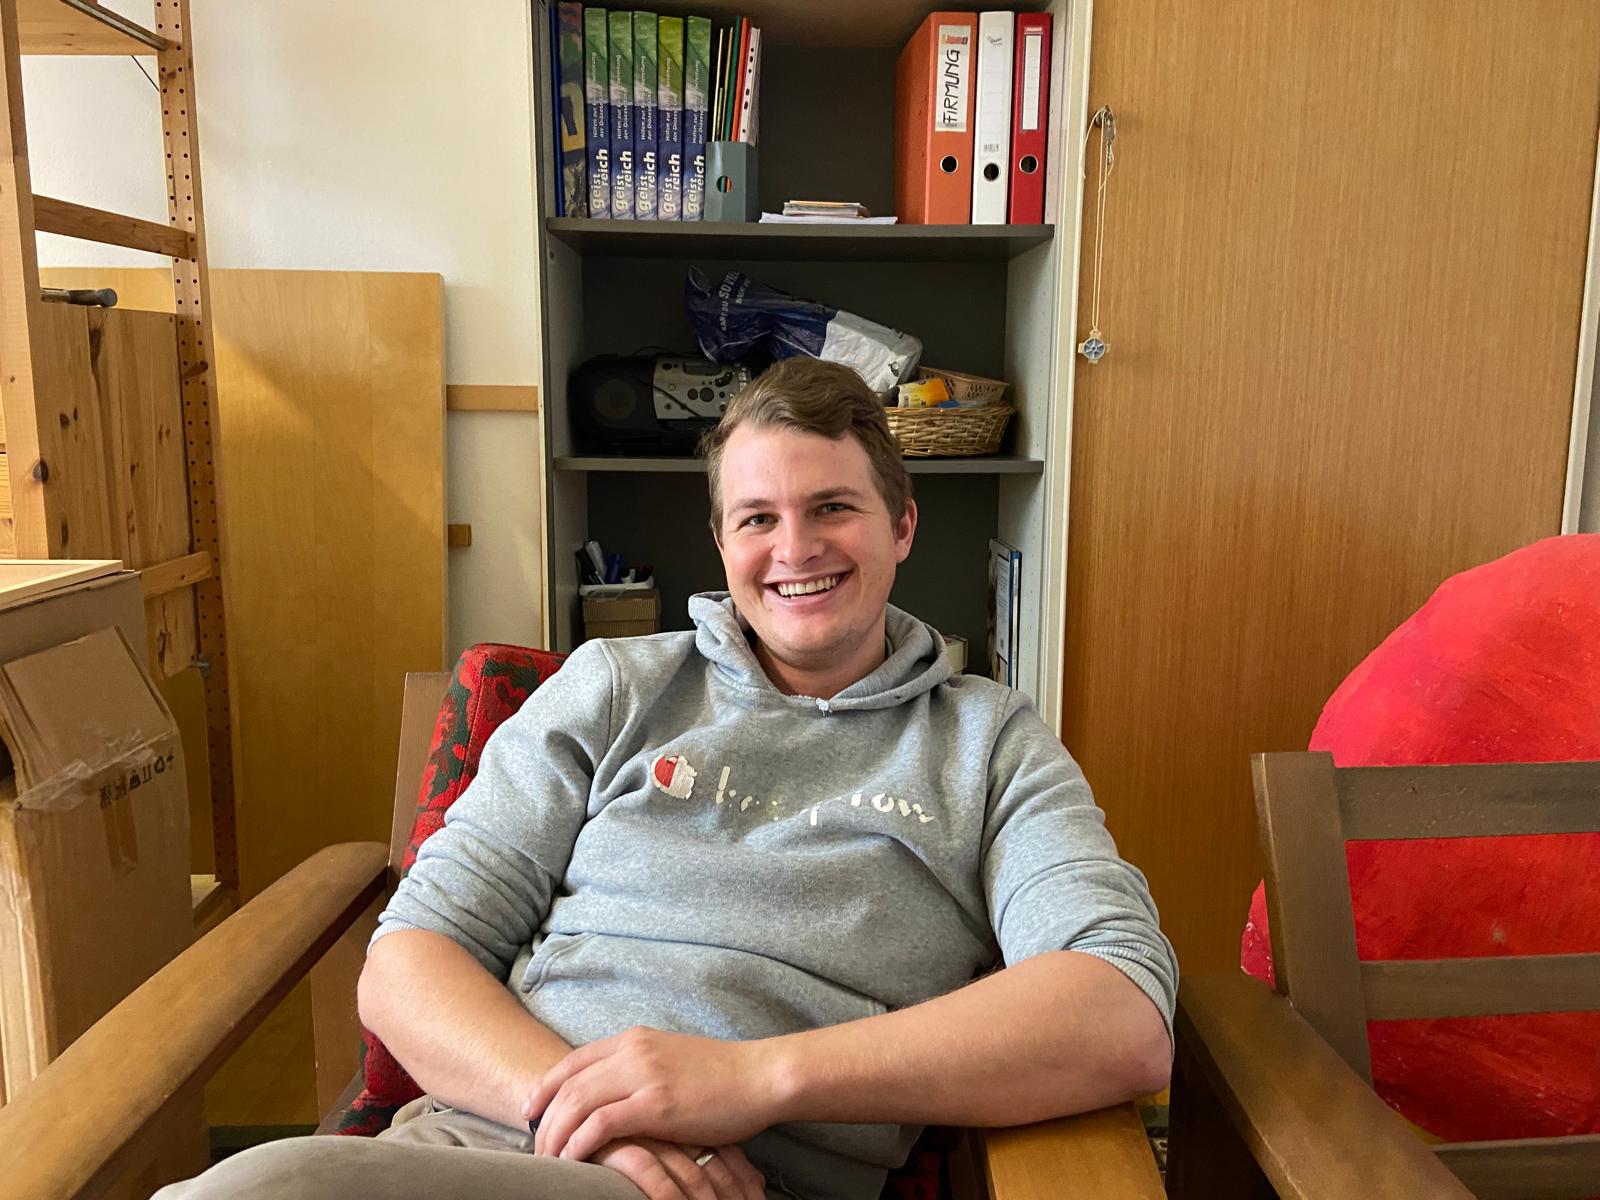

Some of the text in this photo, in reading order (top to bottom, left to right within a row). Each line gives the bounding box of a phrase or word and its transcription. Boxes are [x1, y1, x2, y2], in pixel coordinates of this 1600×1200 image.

[943, 49, 960, 124] FIRMUNG
[596, 149, 608, 186] reich
[620, 151, 632, 187] reich
[644, 152, 655, 188] reich
[669, 154, 680, 190] reich
[694, 155, 704, 191] reich
[591, 173, 604, 209] geist
[615, 175, 628, 210] geist
[638, 175, 651, 211] geist
[663, 178, 676, 213] geist
[687, 178, 699, 213] geist
[719, 283, 732, 299] SO
